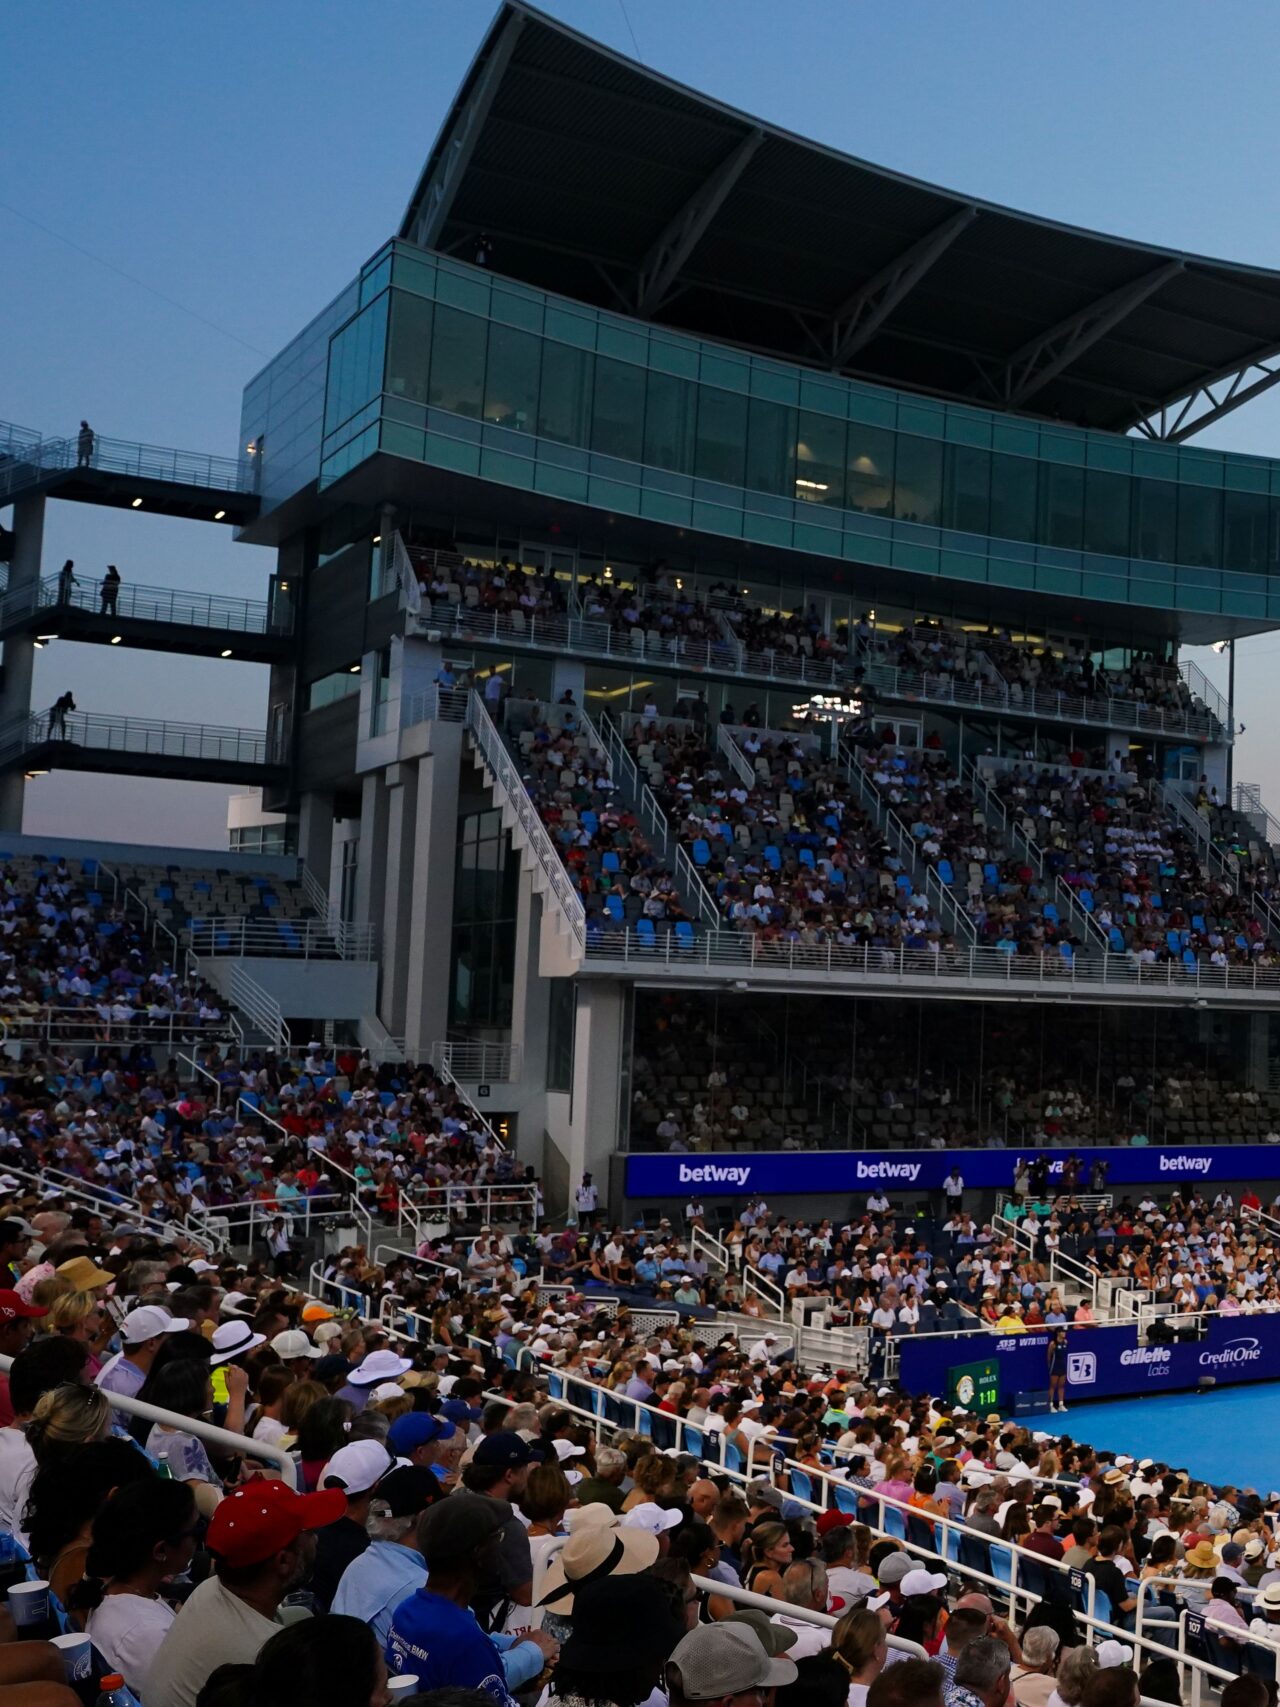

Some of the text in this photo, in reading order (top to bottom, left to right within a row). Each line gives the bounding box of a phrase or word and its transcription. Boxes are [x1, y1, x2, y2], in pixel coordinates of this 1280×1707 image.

[856, 1161, 921, 1181] betway
[1160, 1155, 1212, 1173] betway
[679, 1164, 750, 1186] betway
[1120, 1347, 1171, 1365] Gillette
[1199, 1347, 1261, 1365] CreditOne
[1147, 1363, 1170, 1377] Labs
[1189, 1621, 1200, 1633] 107
